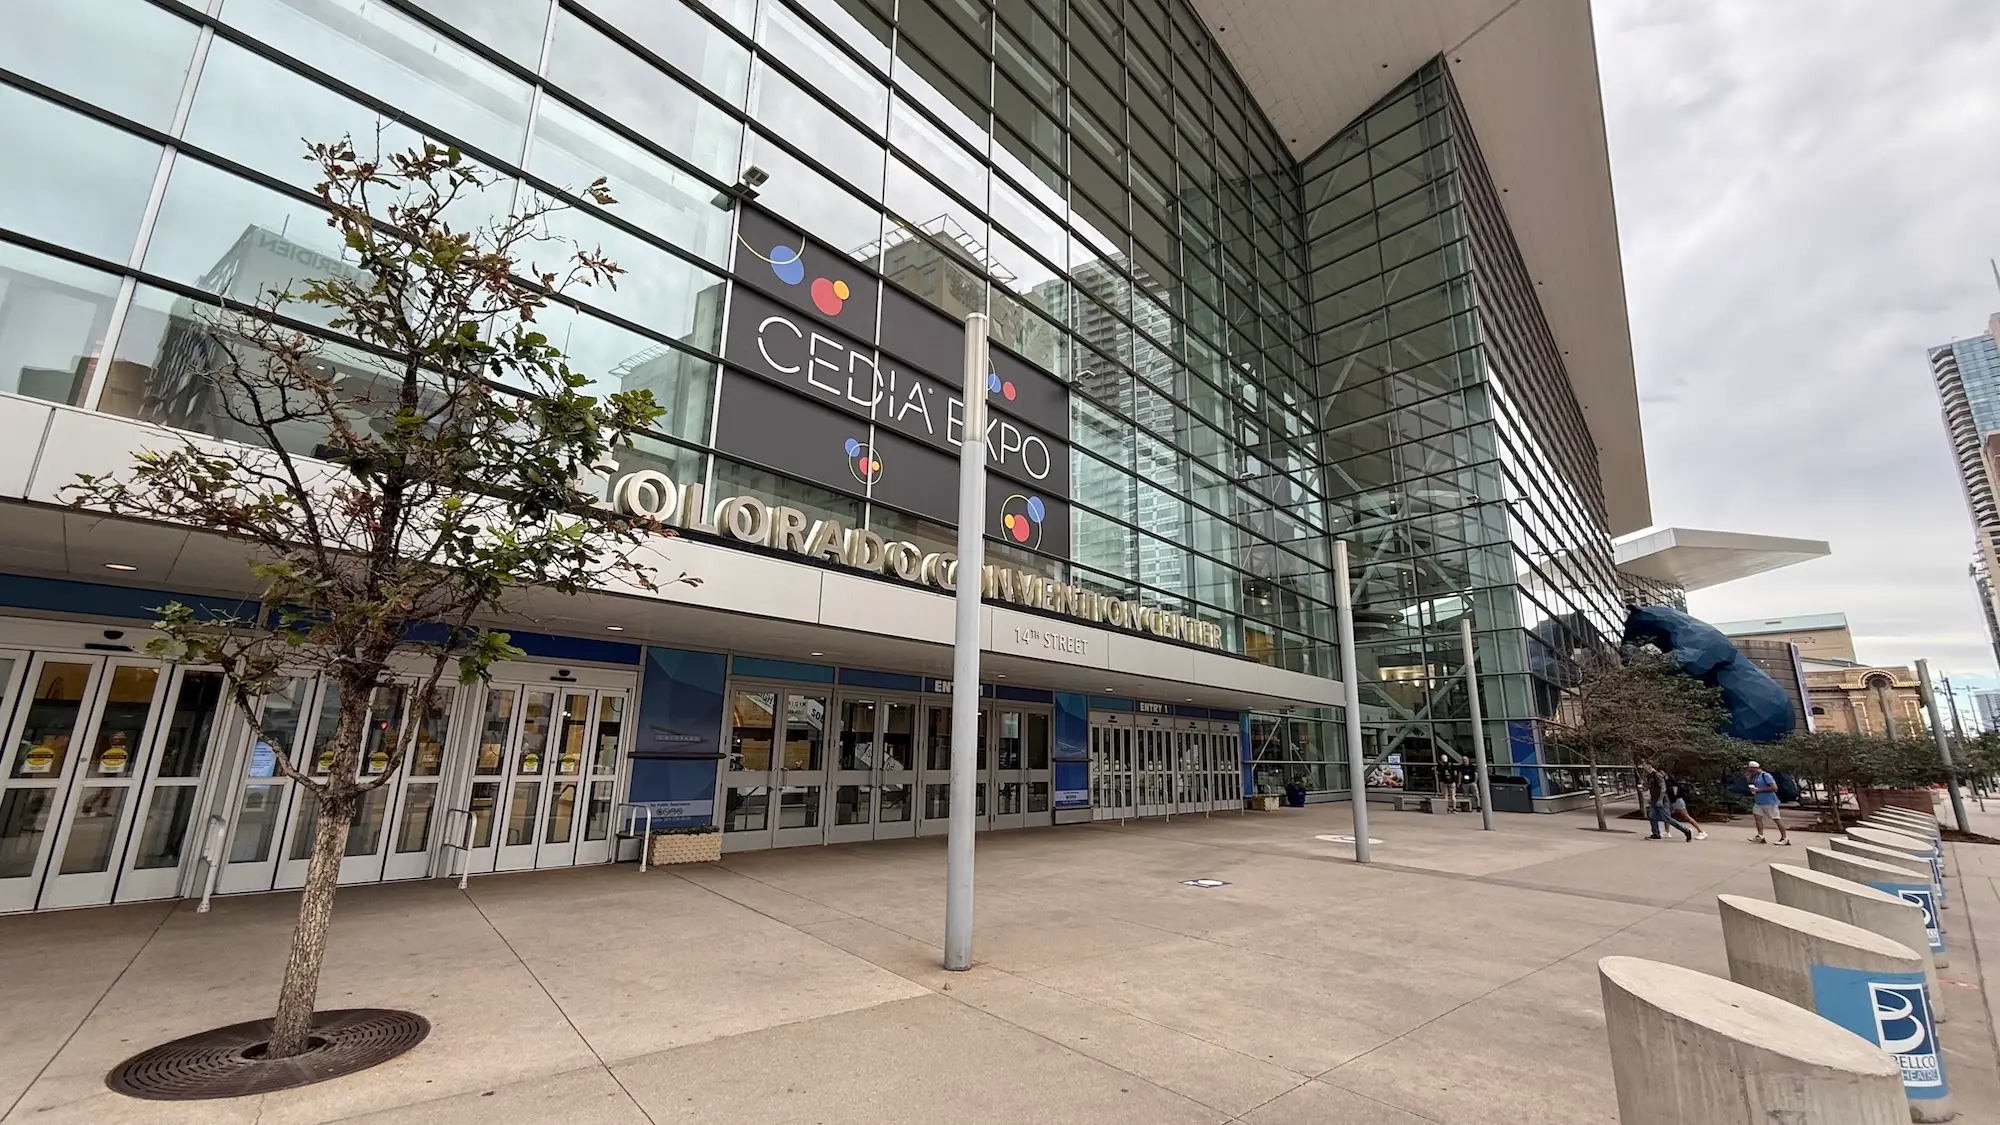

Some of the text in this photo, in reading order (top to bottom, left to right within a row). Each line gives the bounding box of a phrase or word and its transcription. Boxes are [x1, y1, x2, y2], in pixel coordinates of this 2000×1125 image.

[932, 552, 1144, 632] CNVENTION
[1146, 606, 1223, 650] CENTER
[1014, 626, 1088, 655] 14TH STREET
[1139, 702, 1169, 714] ENTRY 1
